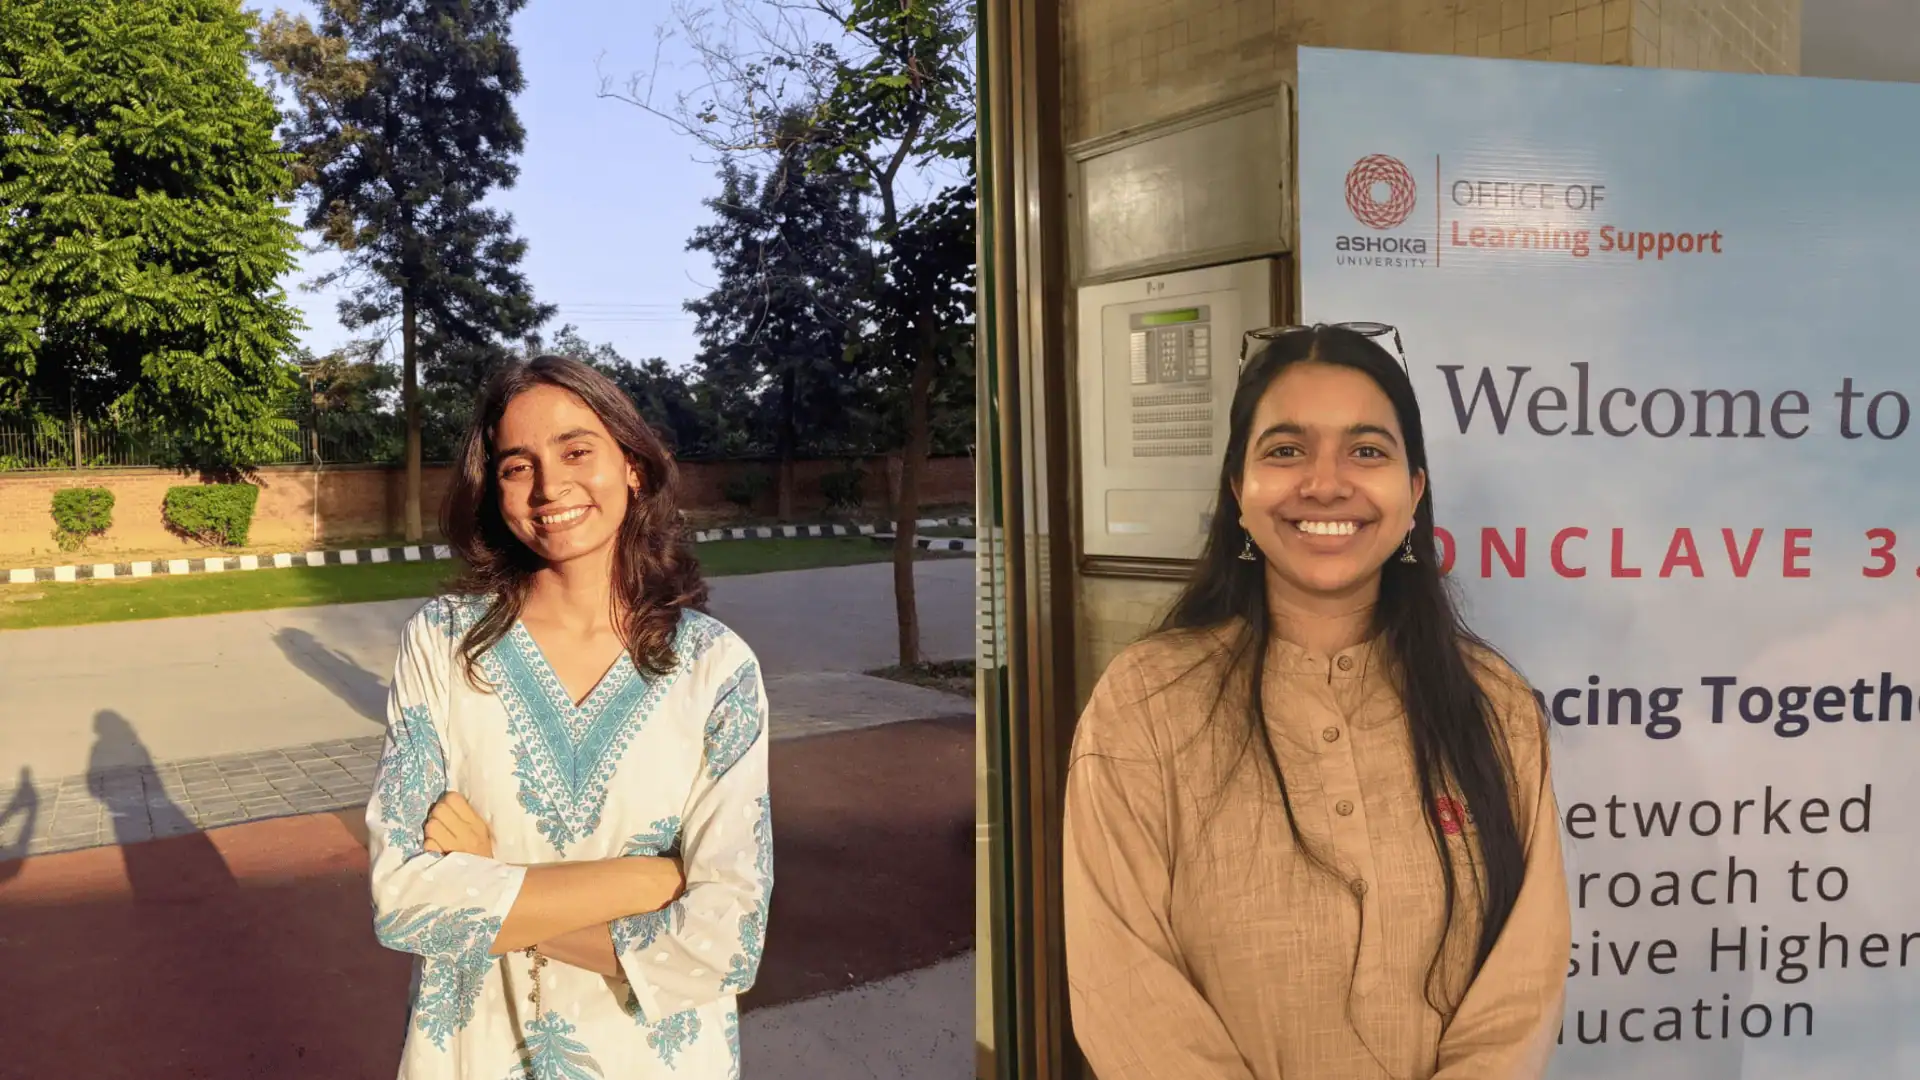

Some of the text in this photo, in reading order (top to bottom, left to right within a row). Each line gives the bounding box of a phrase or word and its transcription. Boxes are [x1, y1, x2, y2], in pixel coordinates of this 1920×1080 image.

[1451, 180, 1606, 211] OFFICE OF
[1336, 257, 1428, 268] UNIVERSITY
[1451, 219, 1723, 261] Learning Support
[1437, 362, 1911, 441] Welcome to
[1532, 671, 1920, 740] cing Togeth
[1565, 784, 1872, 840] etworked
[1578, 856, 1850, 909] roach to
[1710, 922, 1920, 984] Higher
[1557, 993, 1814, 1046] ucation
